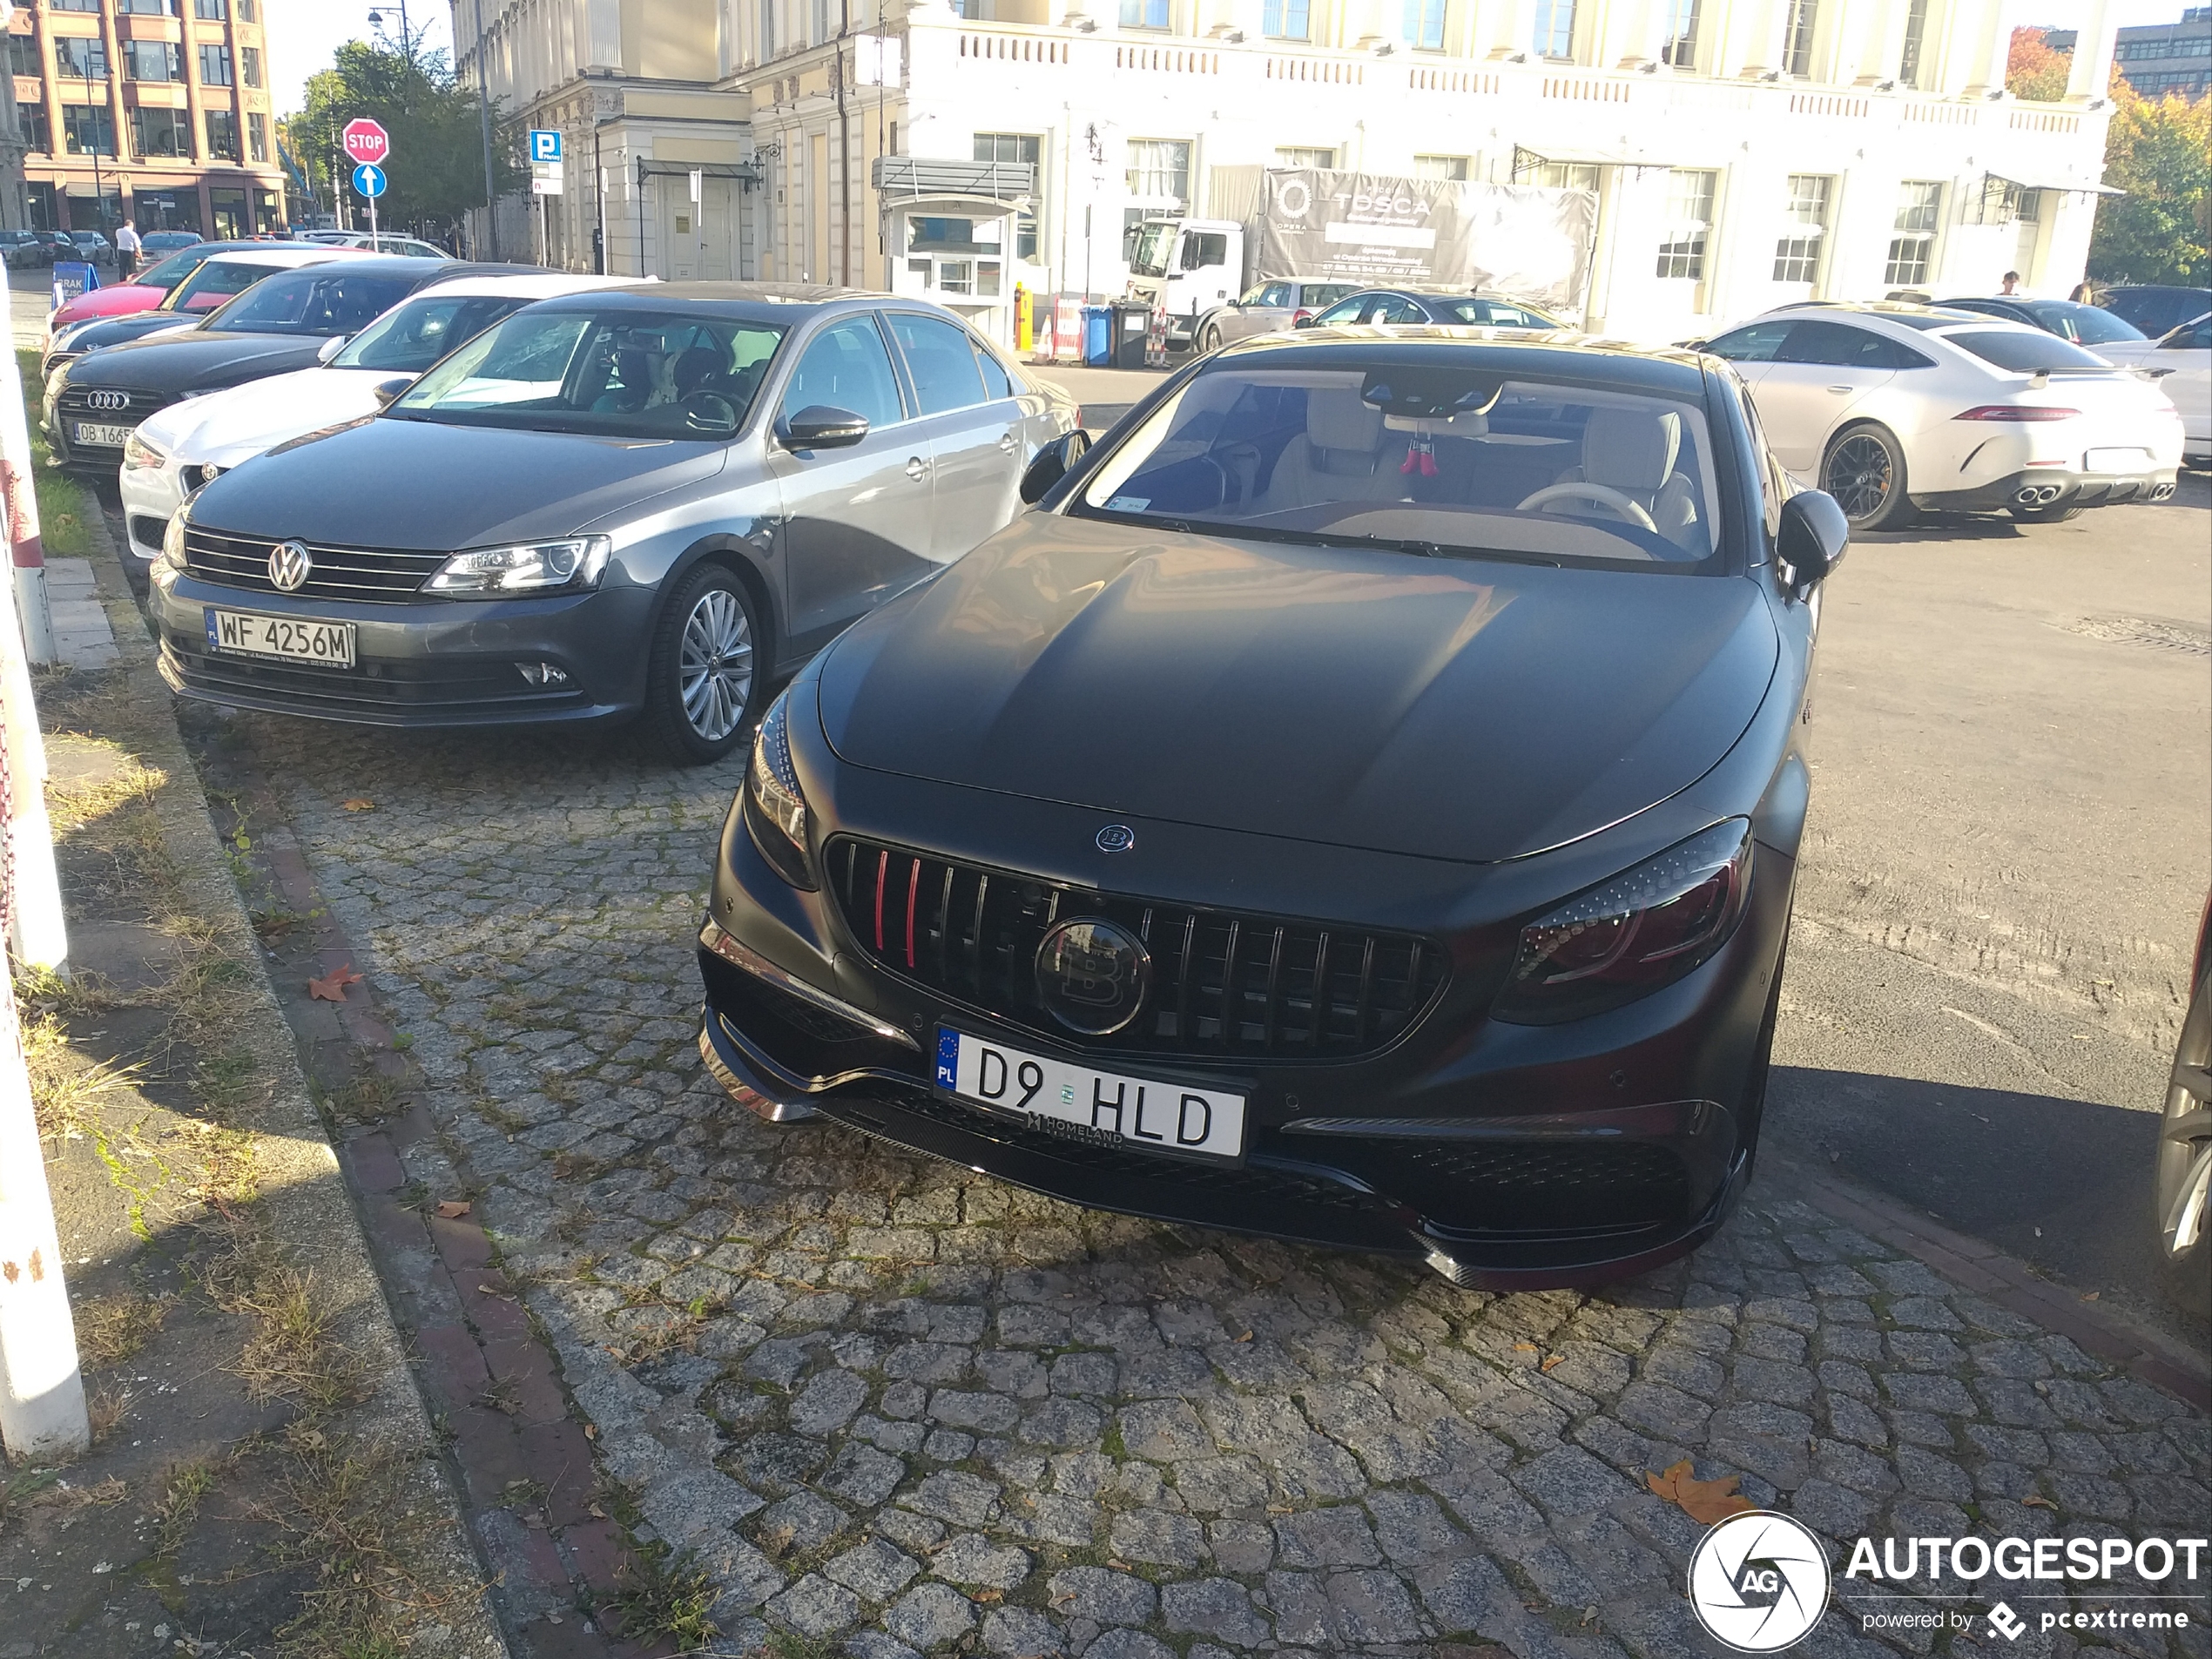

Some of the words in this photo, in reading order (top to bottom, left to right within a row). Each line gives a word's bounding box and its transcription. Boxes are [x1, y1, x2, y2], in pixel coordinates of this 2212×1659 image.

[348, 133, 383, 150] STOP
[536, 133, 556, 159] P
[1334, 192, 1431, 216] TOSCA
[57, 279, 83, 288] BRAK
[81, 425, 97, 441] OB
[101, 427, 135, 443] 1665
[208, 631, 218, 640] PL
[220, 615, 254, 645] WF
[266, 621, 347, 658] 4256M
[937, 1065, 954, 1083] PL
[978, 1045, 1043, 1107] D9
[1090, 1077, 1211, 1146] HLD
[1046, 1129, 1123, 1150] DEVELOPMENT
[1047, 1118, 1123, 1143] HOMELAND
